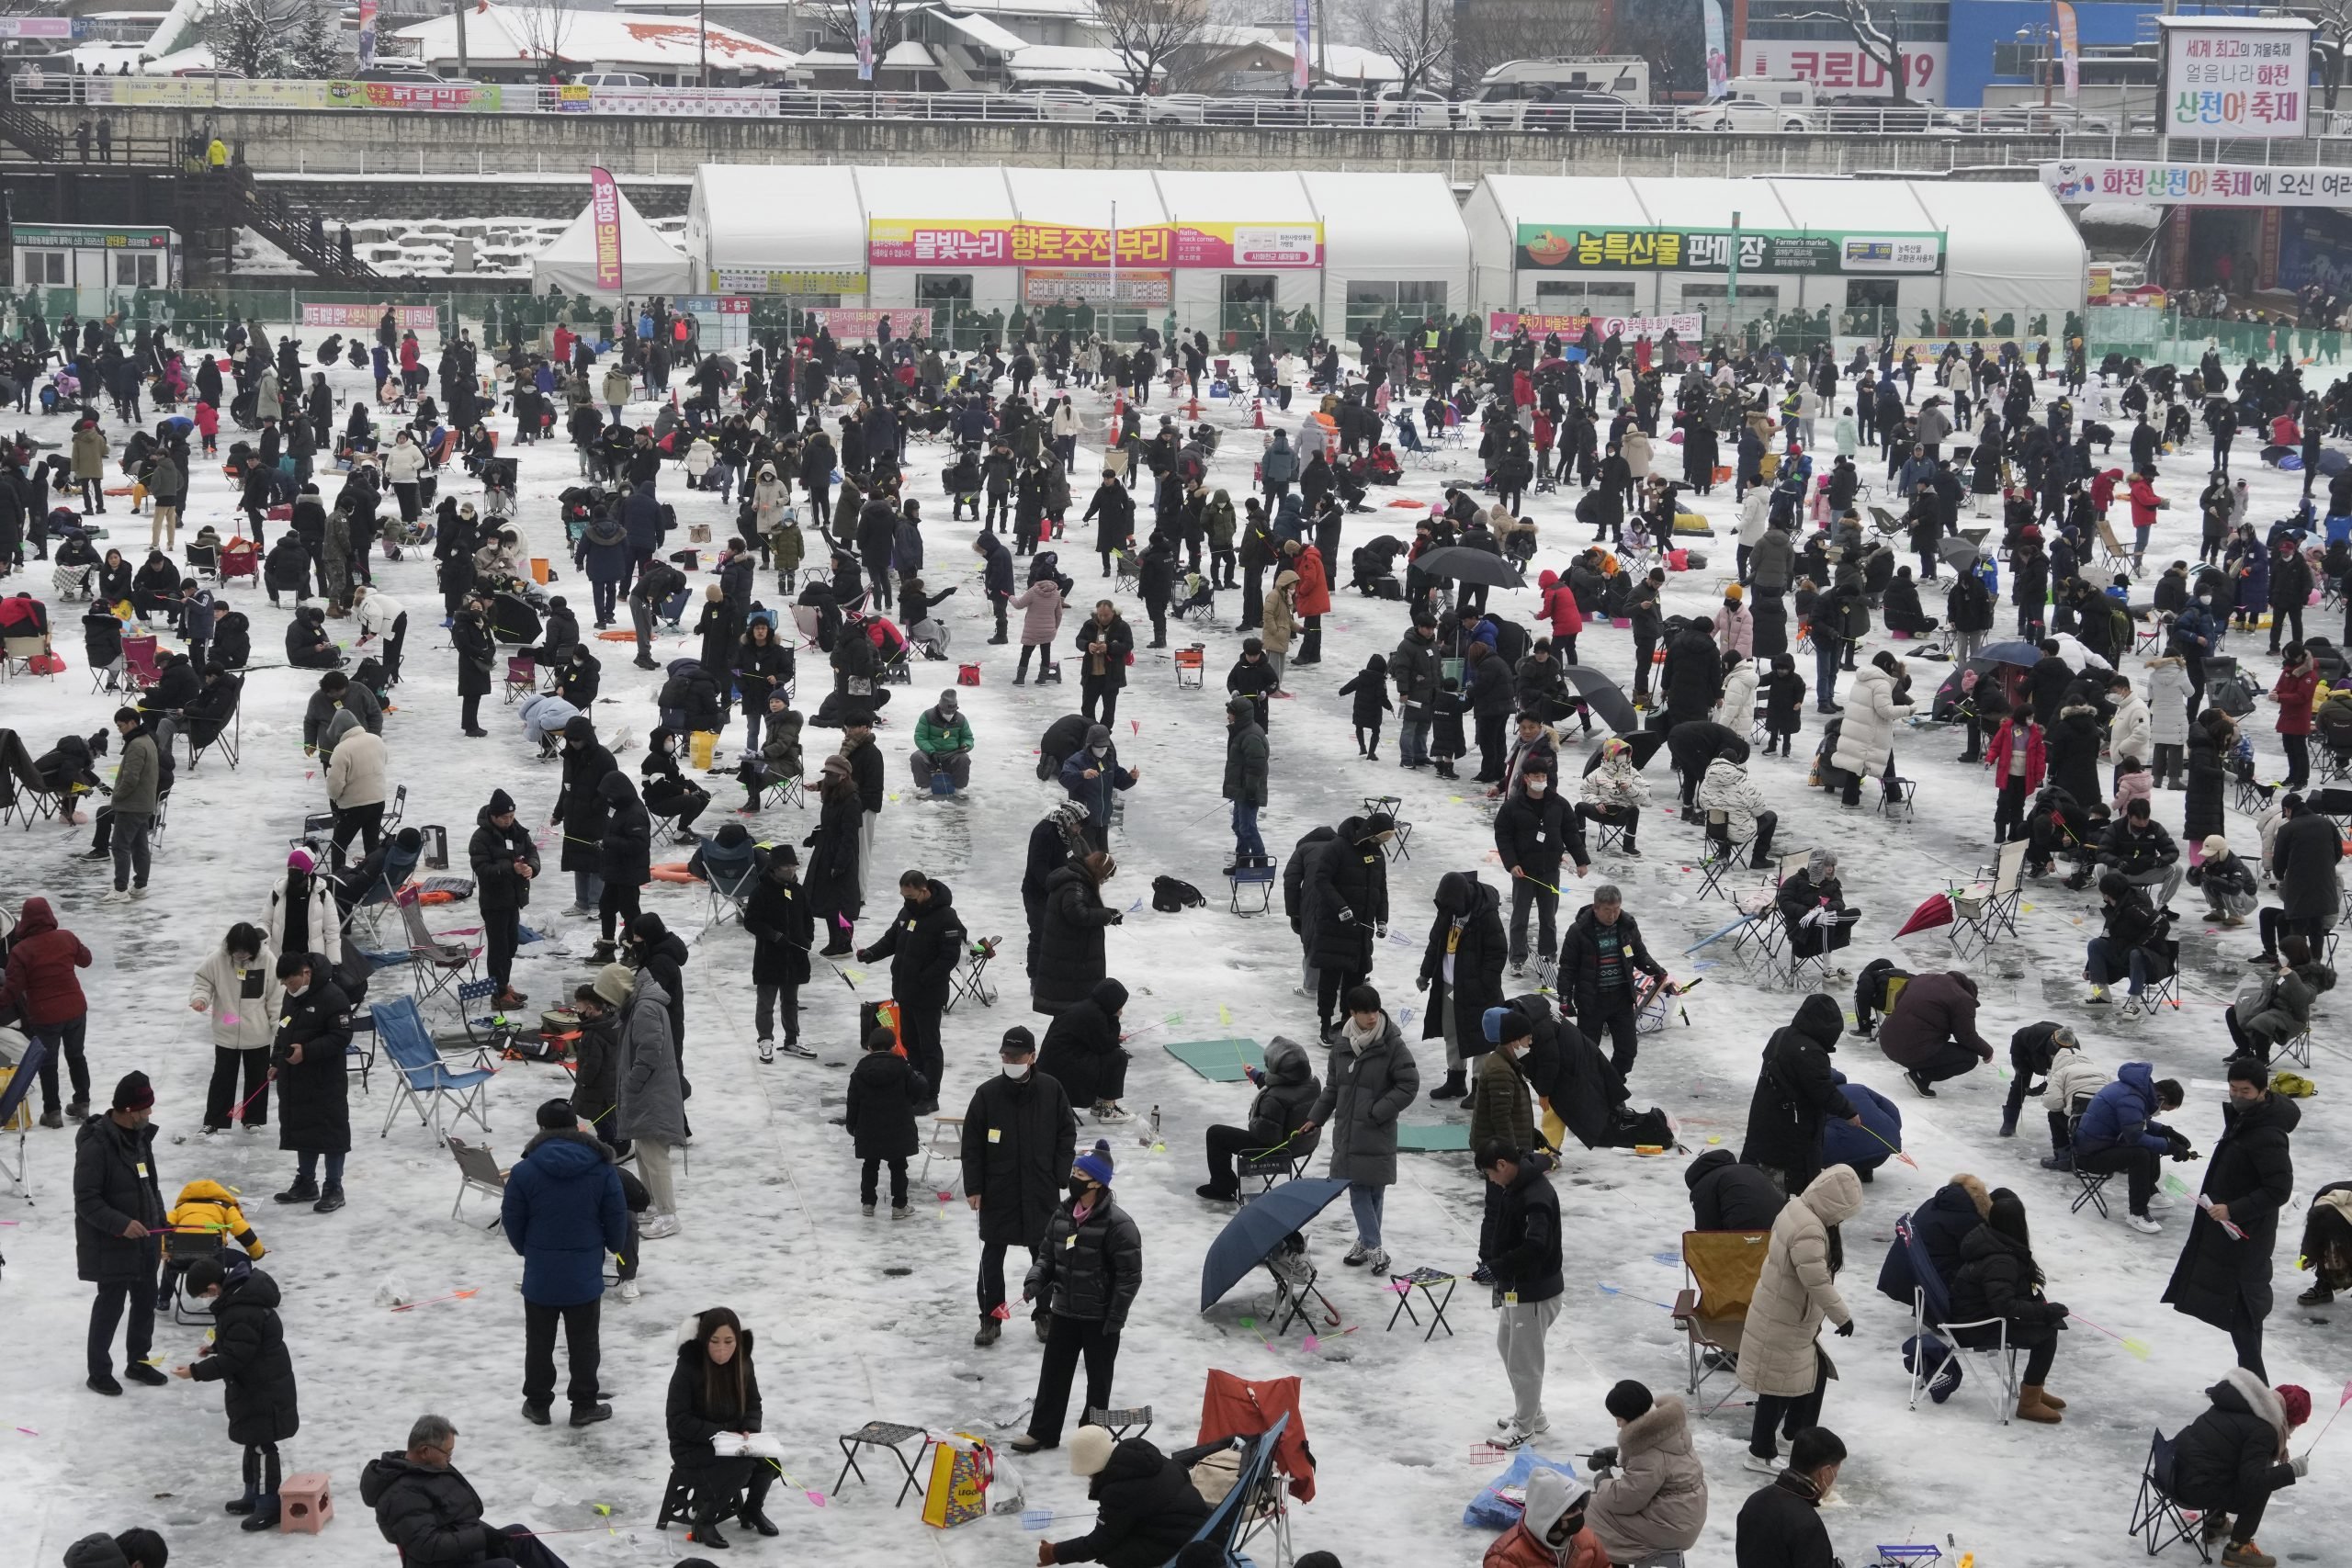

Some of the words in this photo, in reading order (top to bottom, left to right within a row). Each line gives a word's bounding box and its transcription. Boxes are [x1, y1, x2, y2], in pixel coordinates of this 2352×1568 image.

[2187, 39, 2211, 58] 세계
[2216, 39, 2249, 58] 최고의
[2253, 42, 2290, 57] 겨울축제
[2187, 63, 2254, 83] 얼음나라
[2257, 64, 2290, 86] 화천
[2176, 90, 2246, 124] 산천어
[2250, 91, 2298, 124] 축제
[2102, 169, 2143, 196] 화천
[2146, 169, 2209, 197] 산천어
[2211, 170, 2270, 197] 축제에
[2278, 173, 2313, 197] 오신
[15, 235, 28, 244] 2018
[74, 236, 83, 245] 스타
[84, 237, 105, 246] 기타리스트
[914, 231, 1002, 259] 물빛누리
[1578, 233, 1680, 265] 농특산물
[1688, 234, 1766, 267] 판매장
[1897, 244, 1921, 254] 농특산물
[1896, 254, 1916, 264] 교환권
[1917, 254, 1934, 265] 사용처
[1544, 315, 1569, 331] 바늘은
[1627, 317, 1654, 332] 음식물과
